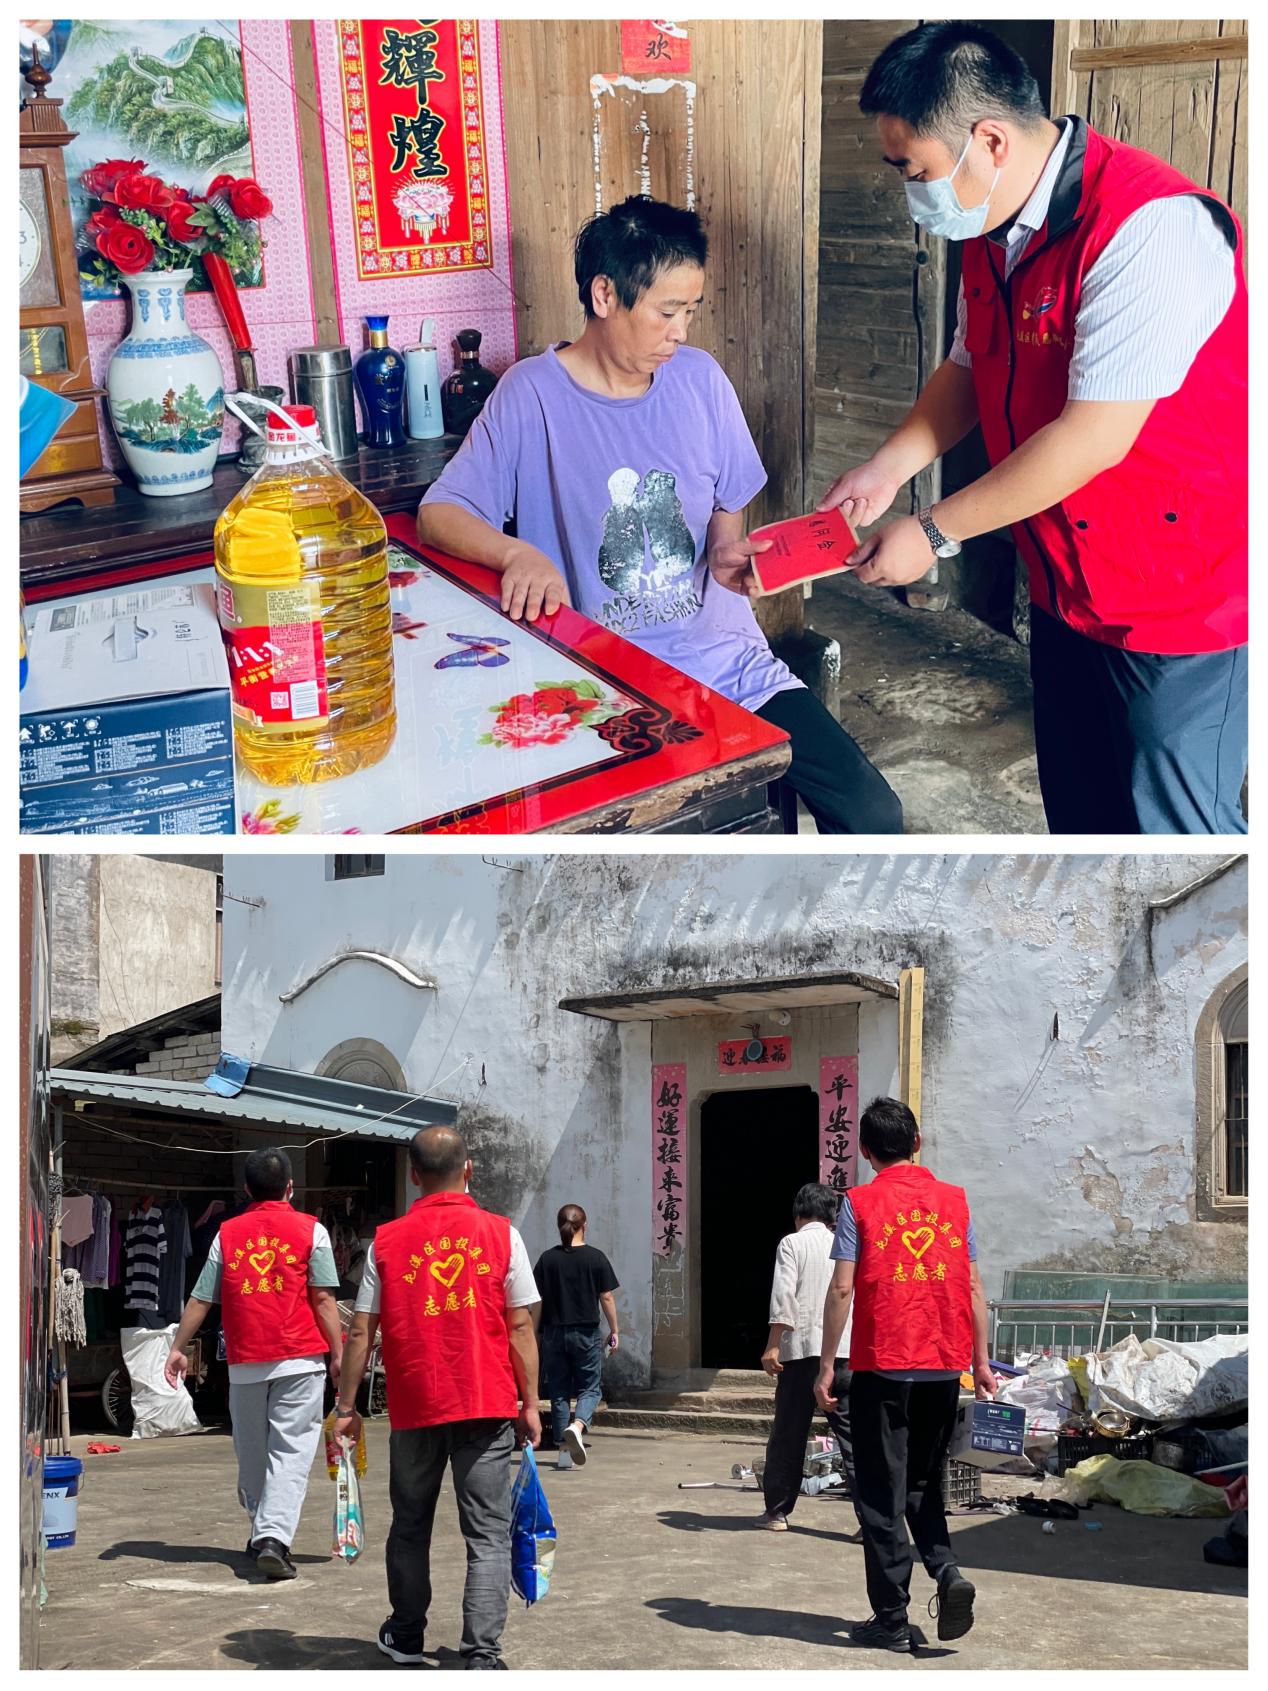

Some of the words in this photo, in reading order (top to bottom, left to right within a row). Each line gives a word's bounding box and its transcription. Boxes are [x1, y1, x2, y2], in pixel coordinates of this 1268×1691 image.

[379, 19, 448, 180] 輝煌
[240, 1274, 284, 1295] 志愿者
[893, 1261, 948, 1282] 志愿者
[423, 1286, 478, 1317] 志愿者
